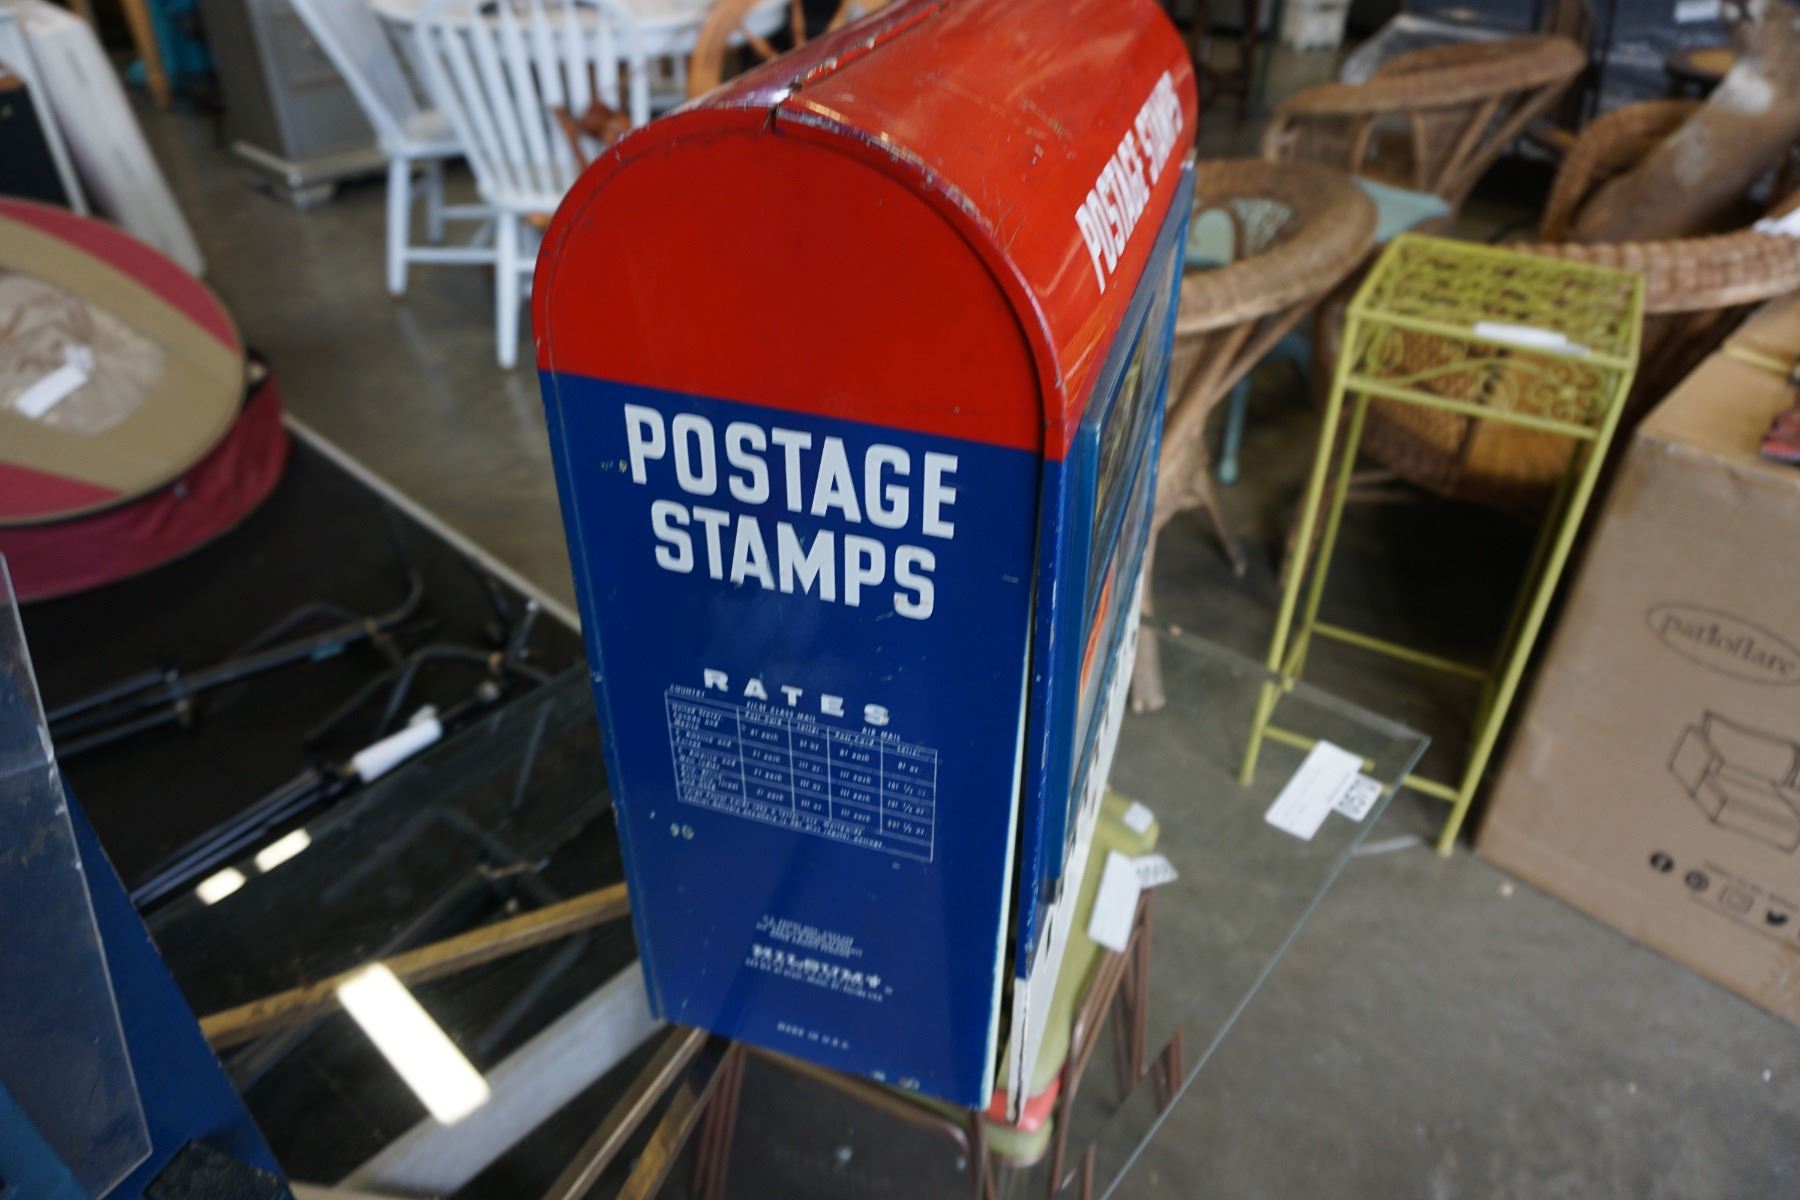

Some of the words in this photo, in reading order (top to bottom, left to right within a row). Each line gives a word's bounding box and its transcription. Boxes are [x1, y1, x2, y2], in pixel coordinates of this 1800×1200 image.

[1074, 128, 1151, 296] POSTAGE
[624, 403, 958, 539] POSTAGE
[651, 500, 936, 620] STAMPS
[704, 668, 889, 726] RATES
